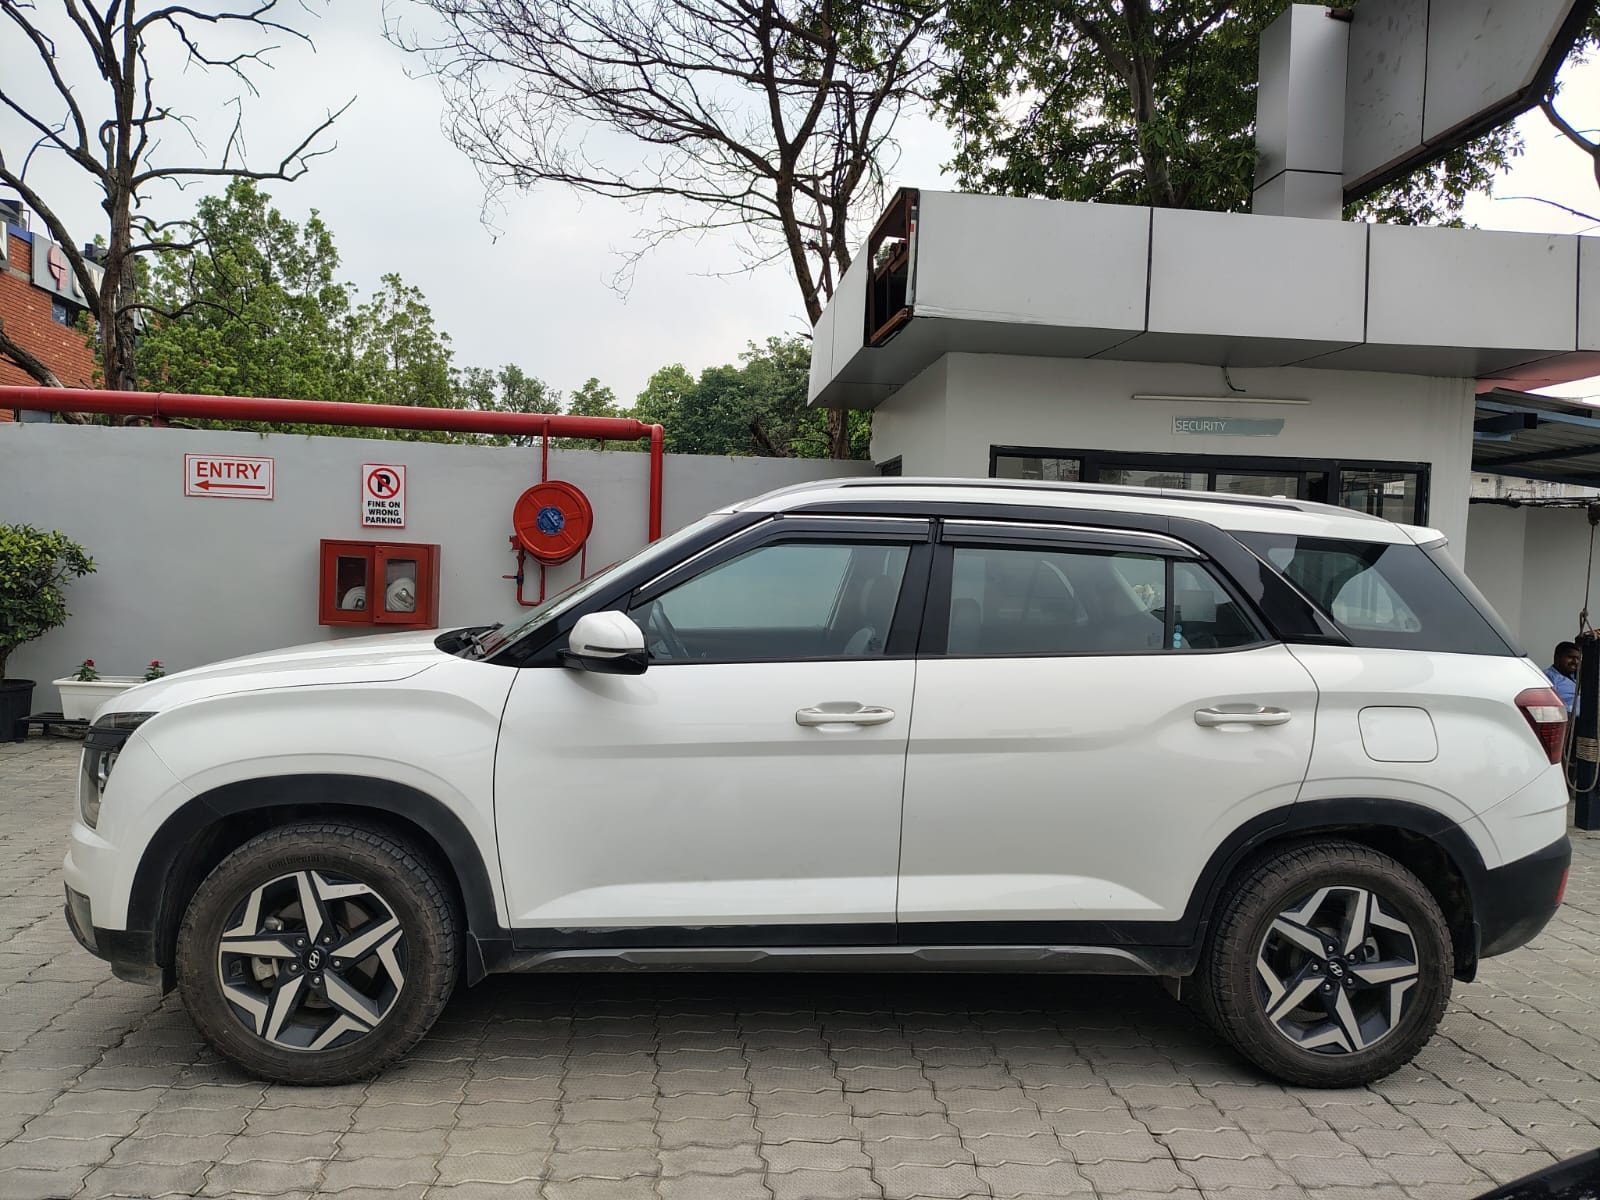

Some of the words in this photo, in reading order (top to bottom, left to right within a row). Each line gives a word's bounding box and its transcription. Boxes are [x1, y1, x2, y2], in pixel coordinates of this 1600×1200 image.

[1175, 420, 1227, 432] SECURITY
[196, 461, 262, 480] ENTRY
[367, 500, 386, 508] FINE
[368, 508, 399, 516] WRONG
[365, 516, 402, 524] PARKING
